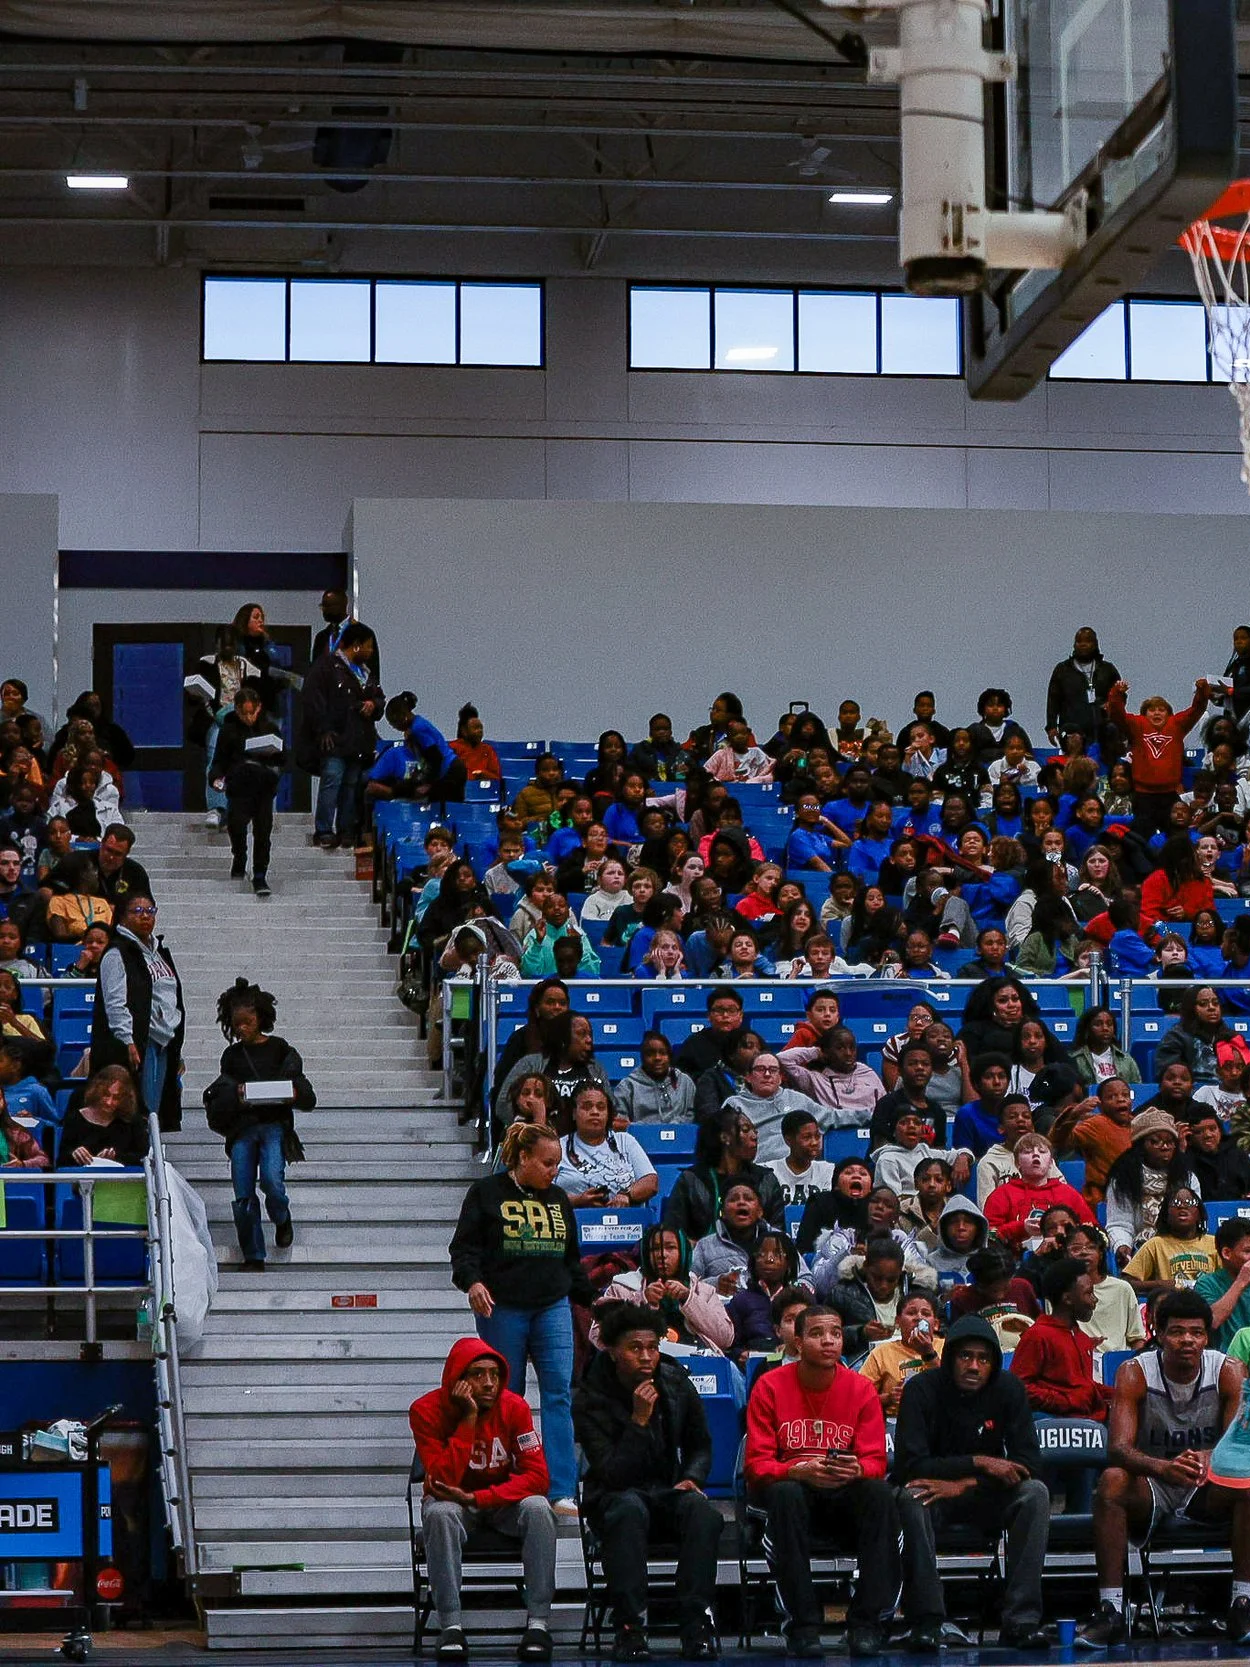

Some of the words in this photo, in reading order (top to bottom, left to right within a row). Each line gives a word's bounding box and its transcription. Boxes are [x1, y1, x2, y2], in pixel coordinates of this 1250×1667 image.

[501, 1200, 552, 1241] SA
[553, 1207, 567, 1239] PRIDE
[610, 1232, 625, 1240] Team
[627, 1232, 640, 1240] Fans
[776, 1421, 855, 1452] 49ERS
[1149, 1426, 1215, 1447] LIONS
[0, 1503, 53, 1527] ADE
